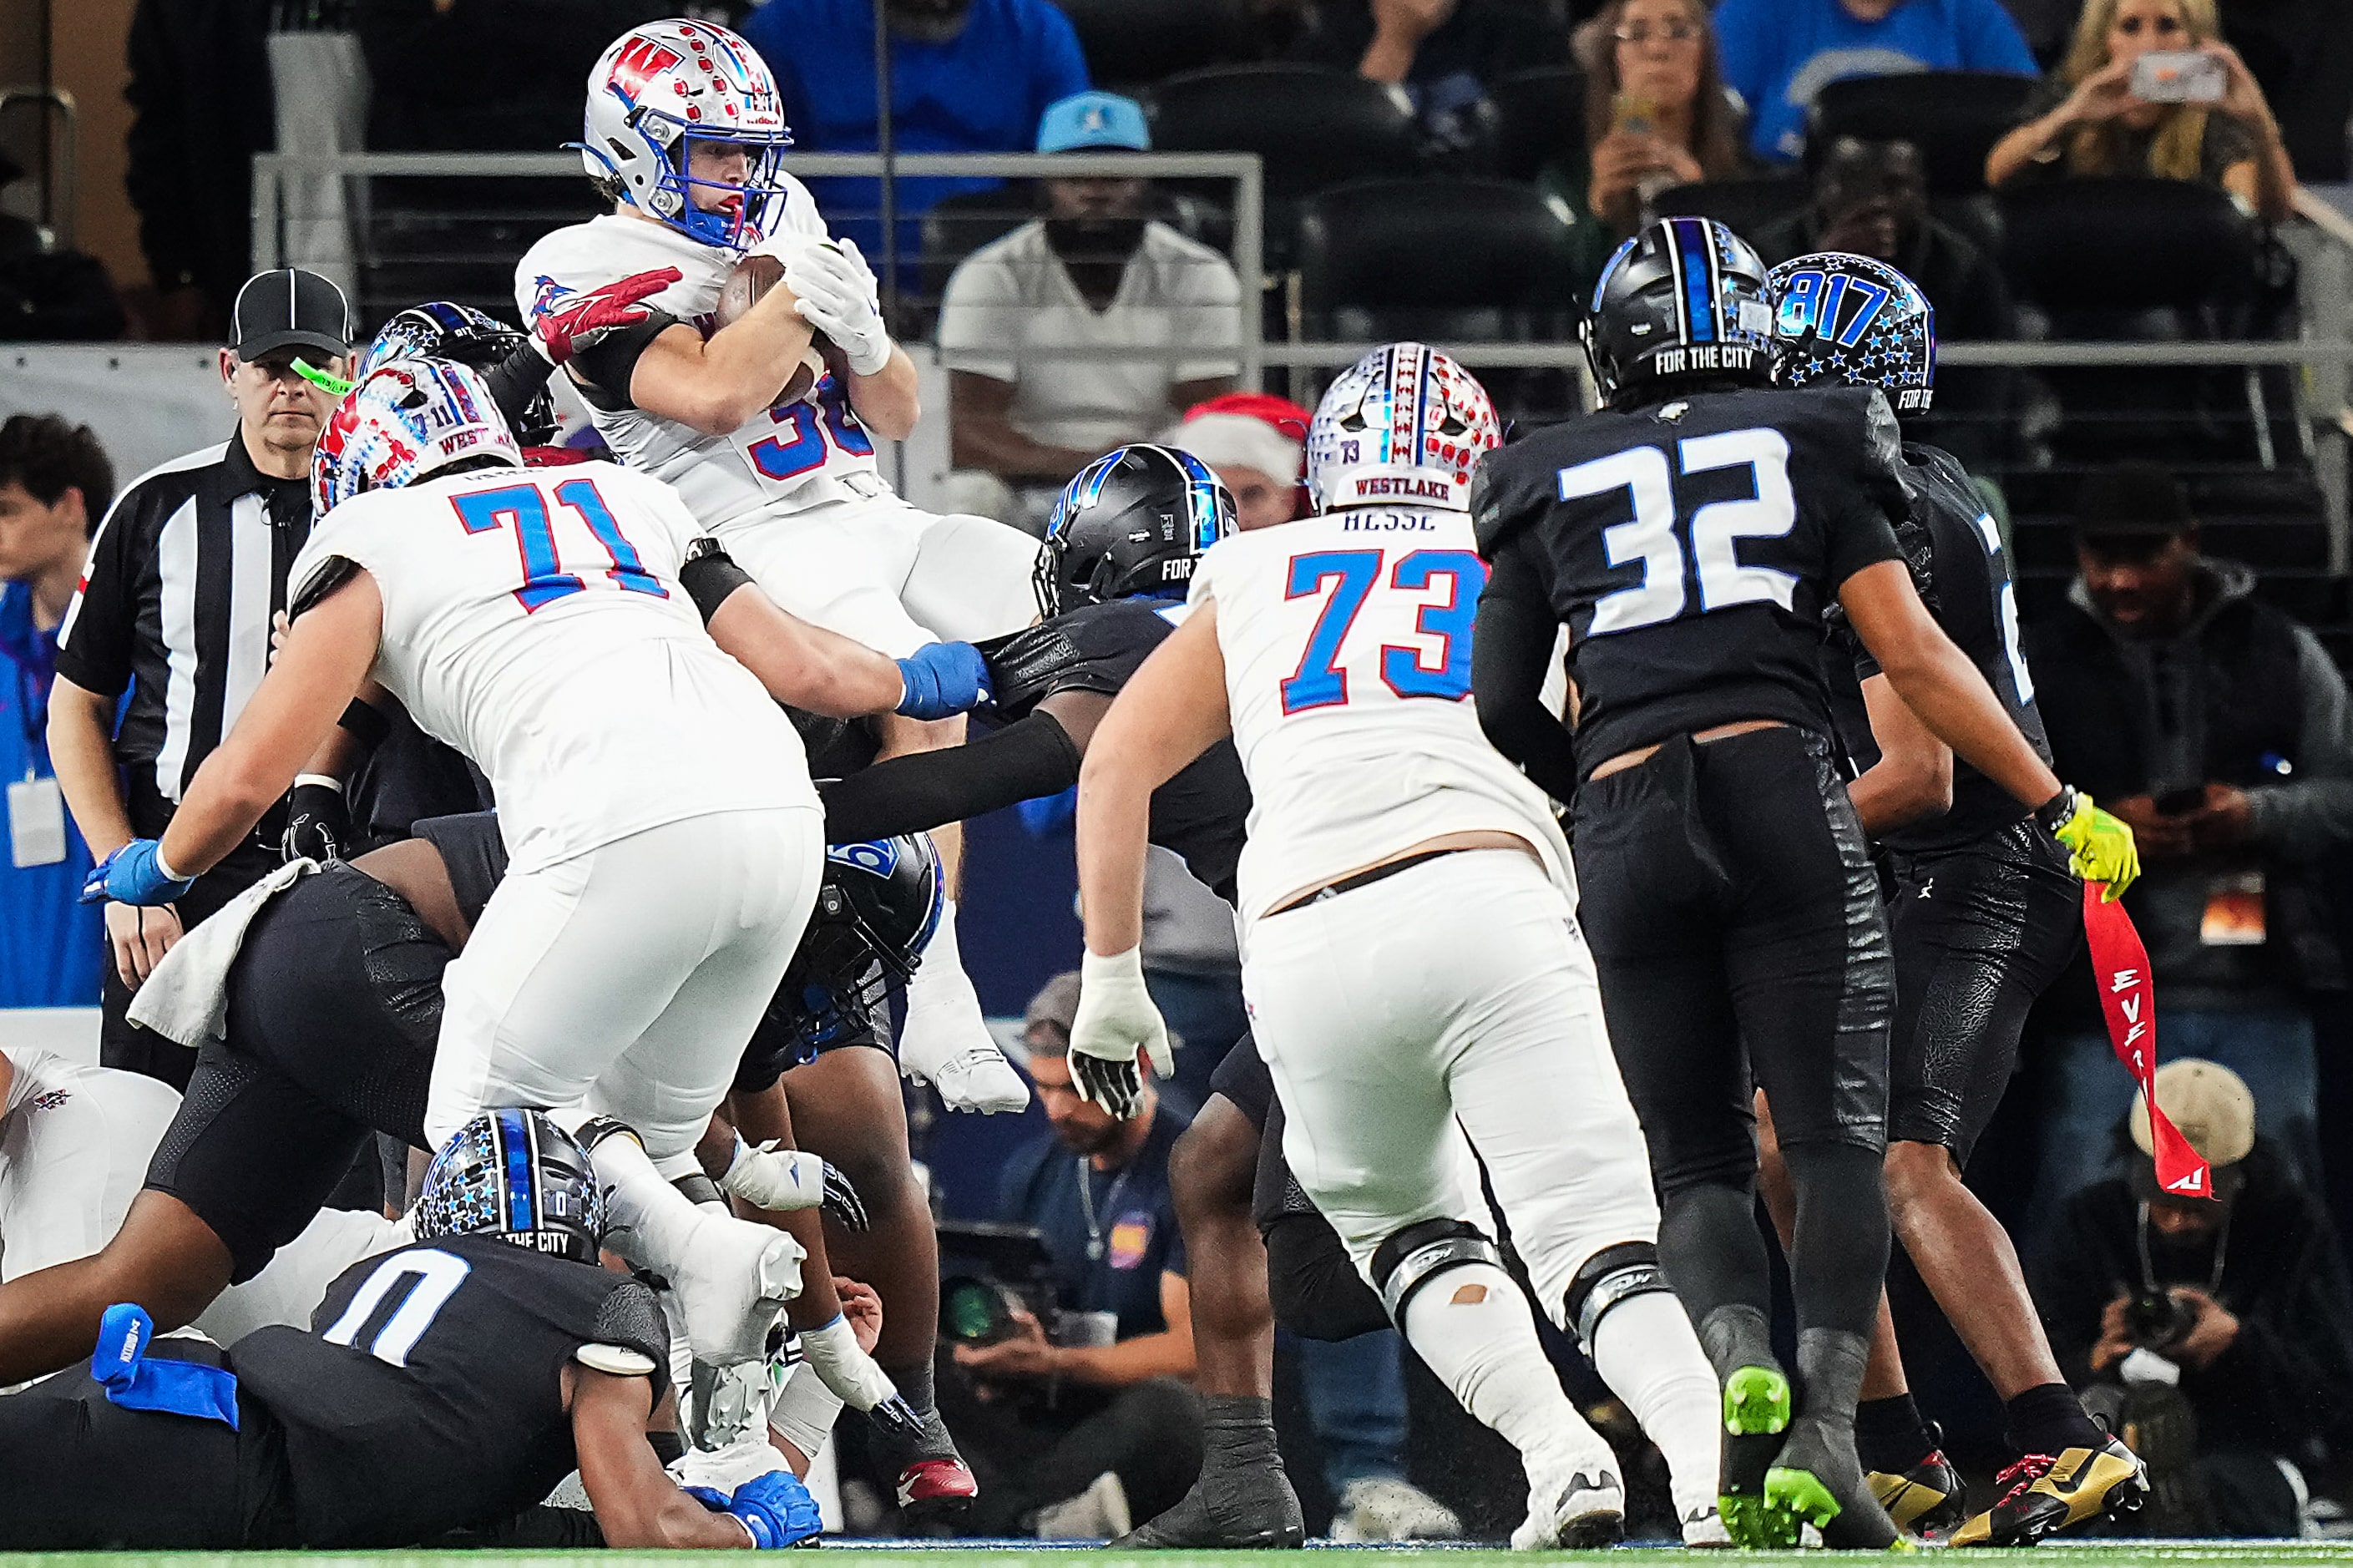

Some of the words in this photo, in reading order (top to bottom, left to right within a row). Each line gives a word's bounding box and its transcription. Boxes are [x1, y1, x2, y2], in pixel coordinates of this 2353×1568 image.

[1776, 271, 1890, 349] 817
[1656, 348, 1686, 375] FOR
[1689, 345, 1719, 369] THE
[1722, 345, 1753, 370] CITY
[1897, 389, 1921, 410] FOR
[1340, 439, 1360, 465] 73
[1356, 478, 1450, 501] WESTLAKE
[448, 473, 670, 615] 71
[1556, 427, 1802, 638] 32
[1161, 559, 1192, 581] FOR
[1280, 549, 1493, 717] 73
[537, 1232, 569, 1254] CITY
